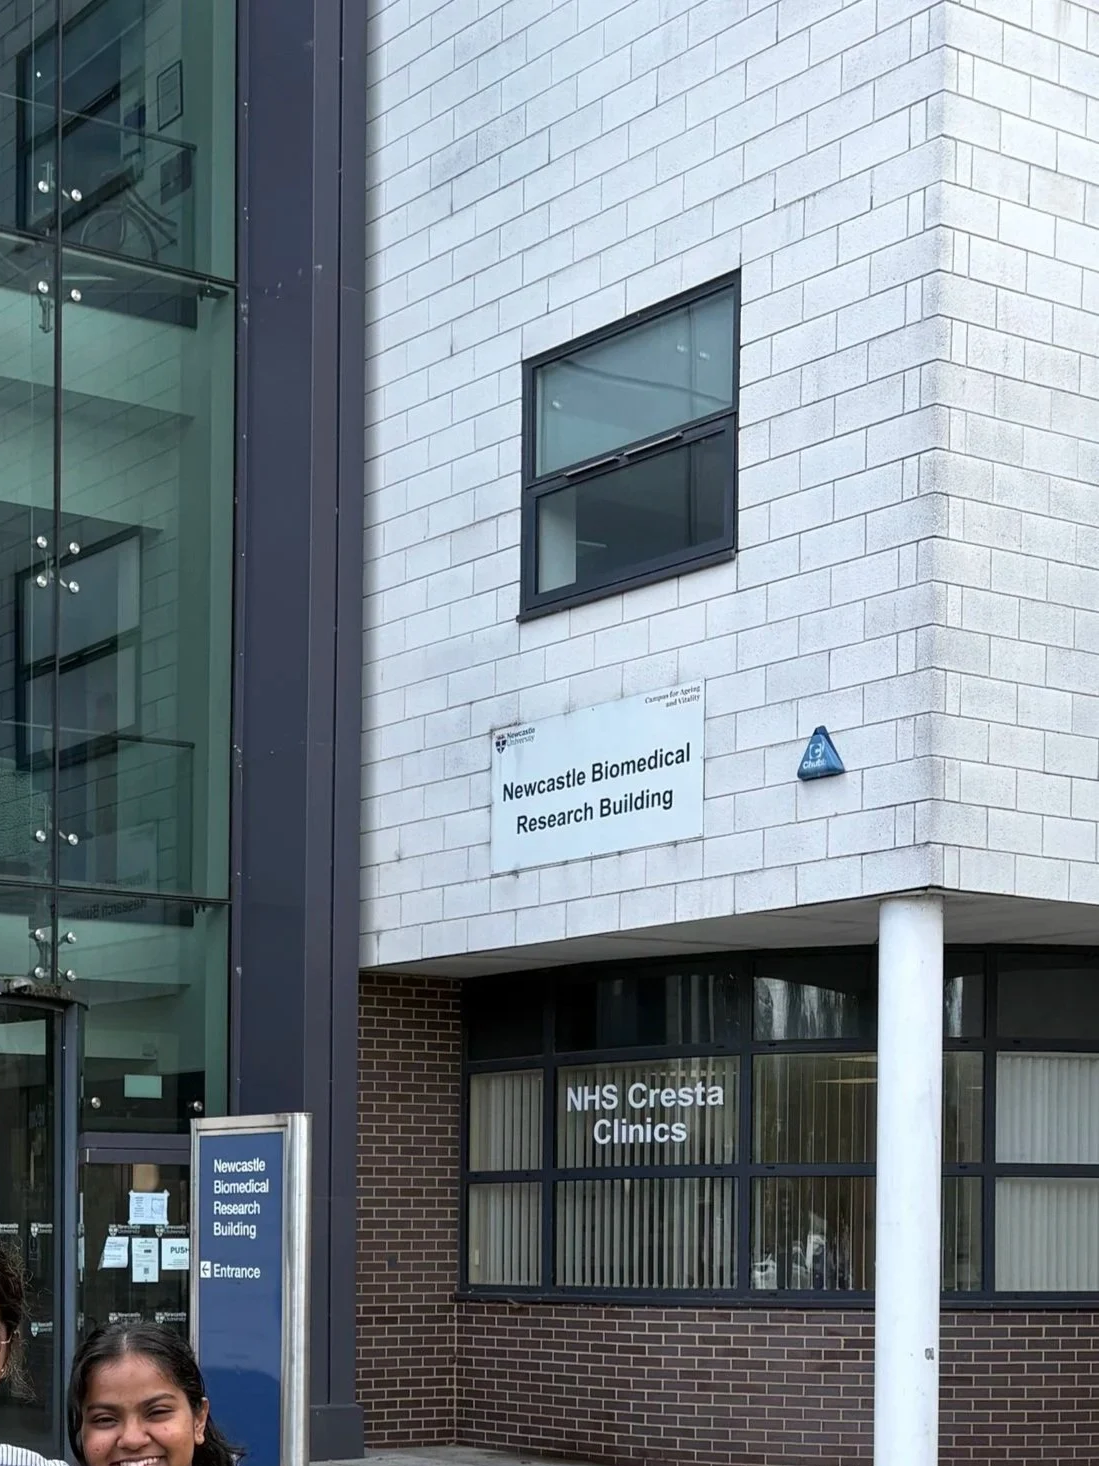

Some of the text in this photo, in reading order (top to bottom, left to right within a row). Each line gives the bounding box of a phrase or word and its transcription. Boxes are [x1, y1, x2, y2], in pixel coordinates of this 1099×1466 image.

[507, 727, 535, 738] Newcastle
[507, 734, 535, 747] University
[502, 742, 691, 802] Newcastle Biomedical
[516, 788, 674, 835] Research Building
[566, 1081, 724, 1112] NHS Cresta
[593, 1117, 687, 1145] Clinics
[213, 1157, 266, 1174] Newcastle
[213, 1178, 270, 1195] Biomedical
[213, 1200, 261, 1216] Research
[213, 1221, 257, 1240] Building
[213, 1263, 261, 1280] Entrance
